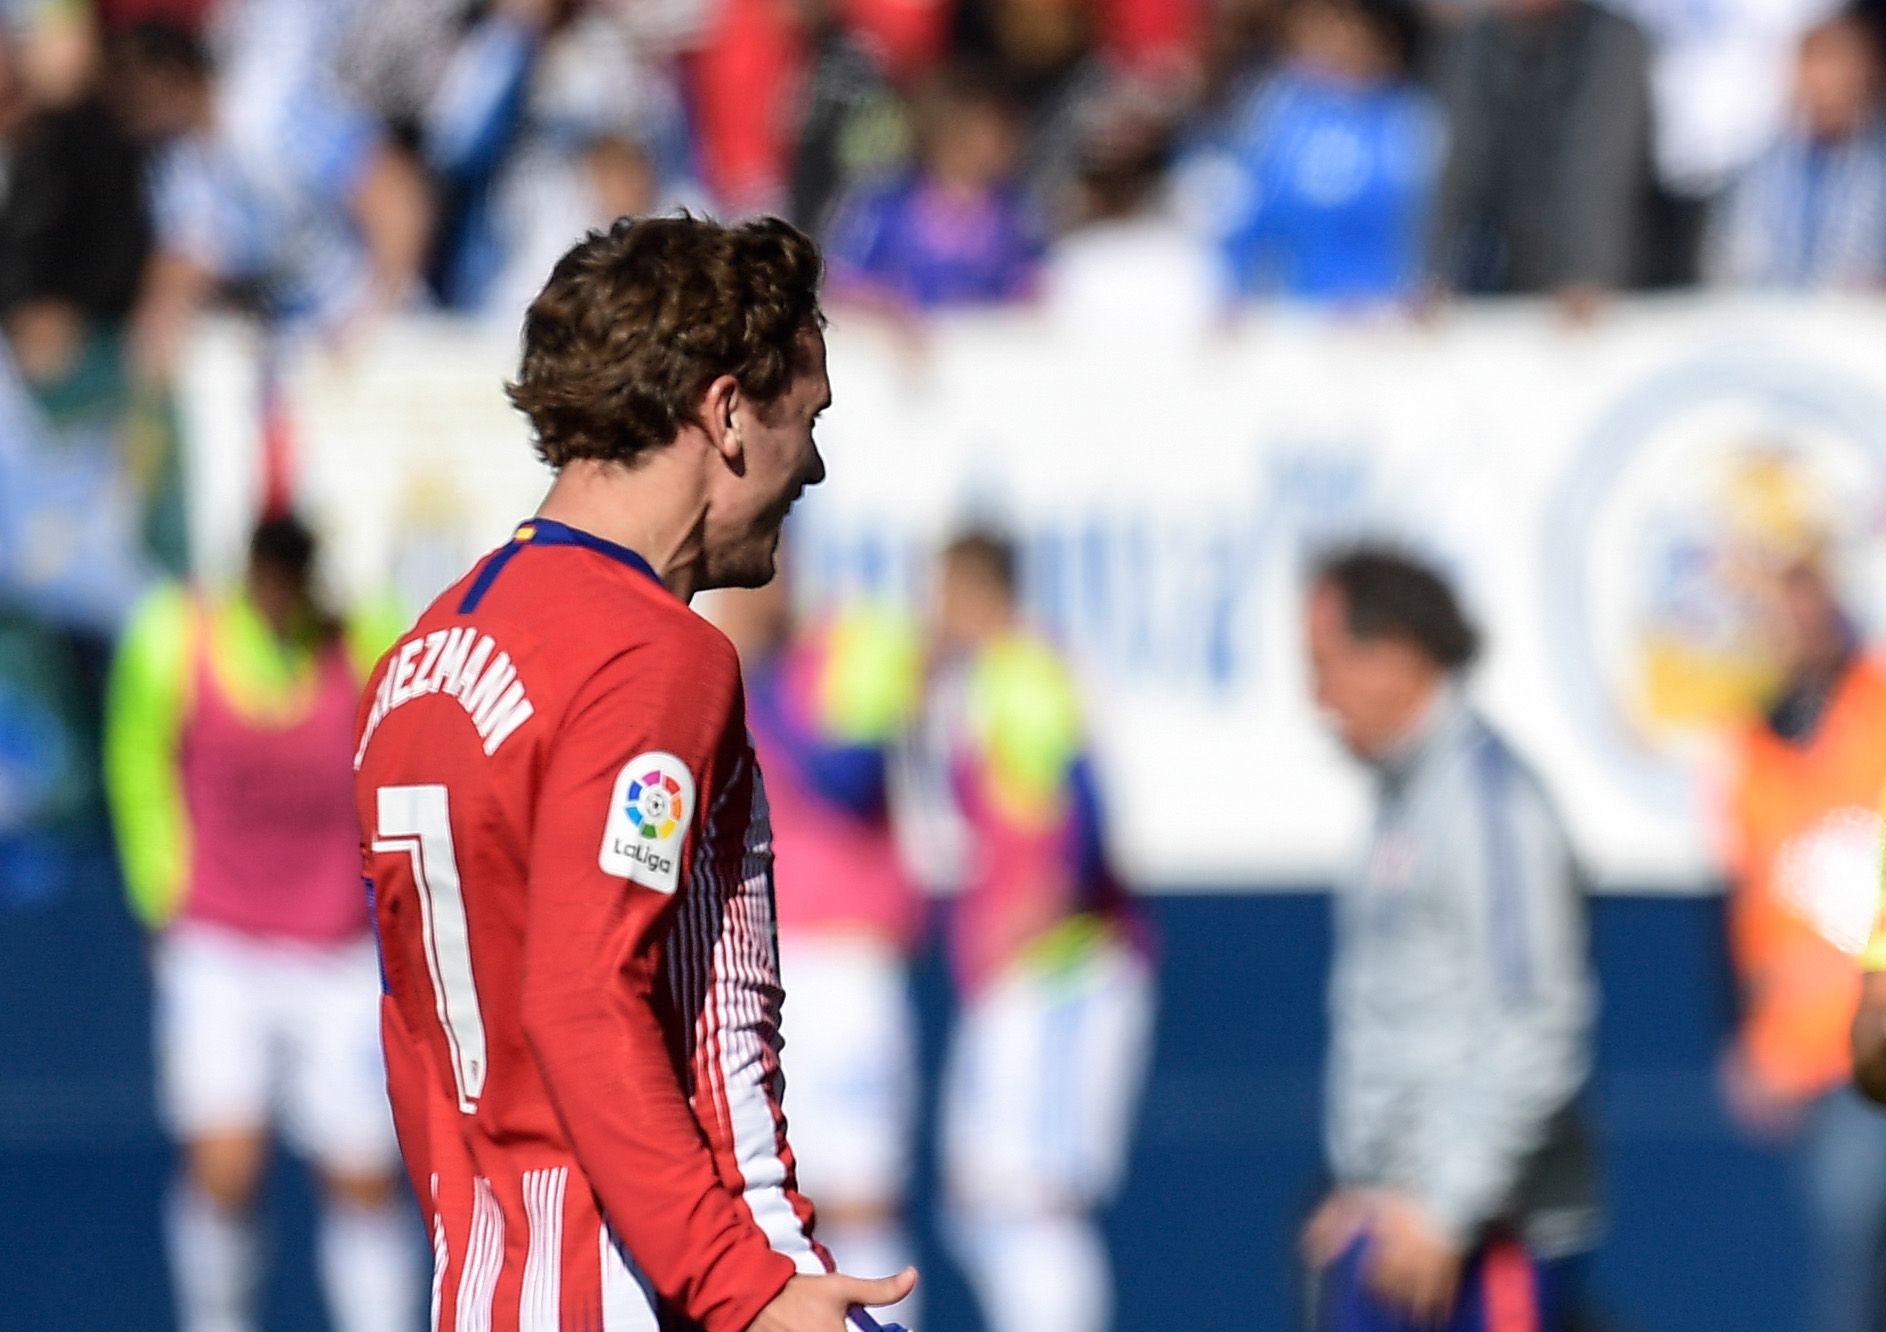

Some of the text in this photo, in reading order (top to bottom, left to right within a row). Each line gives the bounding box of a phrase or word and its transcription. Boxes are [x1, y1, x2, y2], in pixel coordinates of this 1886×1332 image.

[353, 627, 535, 771] IEZMANN
[613, 837, 671, 874] LaLiga
[372, 784, 488, 1115] 7
